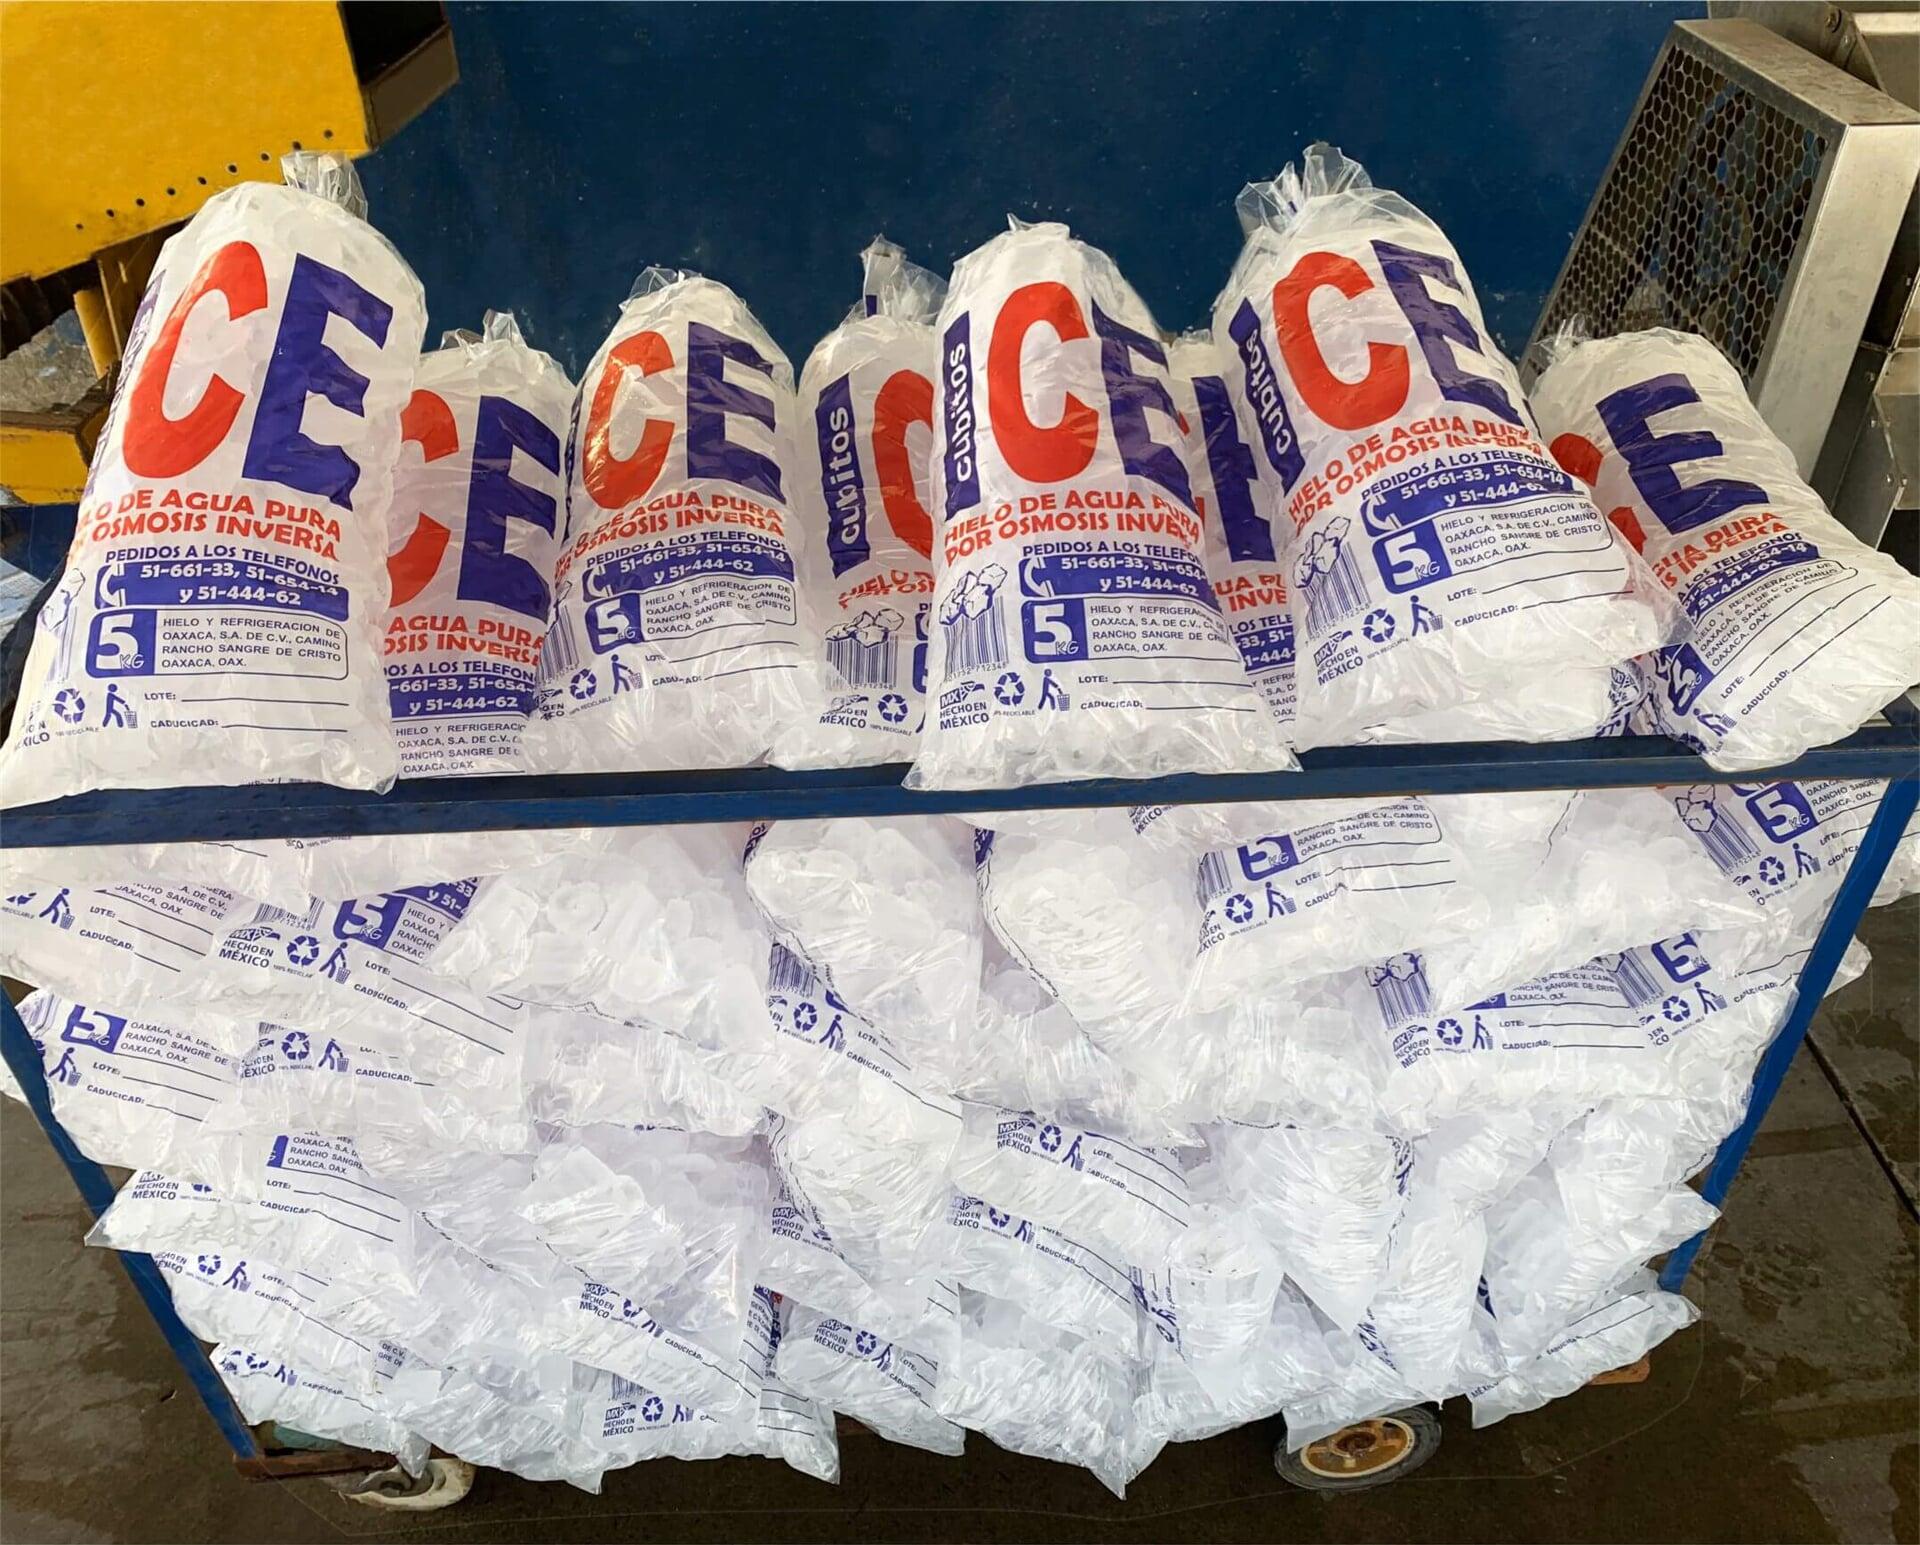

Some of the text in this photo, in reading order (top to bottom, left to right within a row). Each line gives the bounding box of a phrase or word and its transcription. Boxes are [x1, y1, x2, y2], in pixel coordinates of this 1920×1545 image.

[1245, 328, 1292, 455] cubitos
[950, 342, 972, 481] cubitos
[830, 407, 861, 544] cubitos
[1288, 416, 1468, 518] HIELO DE AGUA
[1335, 435, 1440, 496] OSMOSIS
[1361, 452, 1479, 501] PEDIDOS LOS
[1399, 464, 1565, 500] 51-661-33, 51-654-14
[118, 489, 342, 542] DE AGUA PURA
[630, 491, 784, 523] AGUA PURA
[1441, 502, 1575, 531] HIELO REFRIGERACION
[944, 490, 1145, 546] HIELO DE AGUA
[1444, 512, 1598, 544] OAXACA, CAMINO
[92, 510, 340, 562] OSMOSIS INVERSA
[574, 511, 669, 559] OSMOSIS
[675, 508, 785, 537] INVERSA
[945, 511, 1109, 567] POR OSMOSIS
[1450, 524, 1602, 555] RANCHO SANGRE DE CRISTO
[587, 543, 650, 568] PEDIDOS
[668, 534, 696, 546] LOS
[1023, 541, 1141, 557] PEDIDOS LOS
[1384, 532, 1441, 586] 5 KG
[105, 544, 340, 586] PEDIDOS LOS TELEFONOS
[669, 559, 754, 580] 51-444-62
[1061, 556, 1149, 570] 51-661-33,
[140, 563, 339, 597] 51-661-33, 51-654-14
[691, 581, 772, 595] REFRIGERACION
[1115, 575, 1199, 597] 51-444-62
[1729, 565, 1811, 609] REFRIGERACION
[196, 585, 301, 606] 51-444-62
[1447, 588, 1478, 602] LOTE:
[1090, 605, 1121, 614] HIELO
[1454, 605, 1519, 628] CADUCICAD:
[163, 617, 341, 640] HIELO REFRIGERACION DE
[388, 615, 469, 634] AGUA
[595, 598, 629, 646] 5
[1033, 602, 1079, 657] 5 KG
[1091, 617, 1177, 627] OAXACA, DE
[1229, 619, 1255, 635] LOS
[1701, 592, 1769, 650] OAXACA, DE
[1705, 593, 1780, 658] RANCHO SANGRE
[95, 614, 145, 670] 5 KG
[162, 630, 341, 651] OAXACA, S.A. DE CAMINO
[1092, 630, 1203, 640] RANCHO SANGRE DE
[1711, 612, 1772, 667] OAXACA, OAX.
[161, 656, 248, 670] OAXACA, OAX.
[162, 643, 342, 663] RANCHO SANGRE DE CRISTO
[429, 662, 458, 674] LOS
[1317, 655, 1364, 685] MÉXICO
[1078, 675, 1108, 683] LOTE:
[1721, 674, 1745, 699] LOTE:
[144, 691, 177, 702] LOTE:
[1741, 670, 1790, 716] CADUCICAD:
[425, 697, 518, 711] 51-444-62
[150, 718, 220, 730] CADUCICAD:
[395, 727, 428, 736] HIELO
[940, 713, 990, 730] MÉXICO
[398, 736, 486, 748] OAXACA, DE
[400, 748, 493, 760] RANCHO SANGRE
[1811, 787, 1849, 806] RANCHO
[1753, 788, 1802, 836] 5
[1297, 821, 1432, 846] RANCHO SANGRE CRISTO
[1301, 838, 1341, 856] OAXACA,
[1295, 872, 1321, 886] LOTE:
[90, 906, 116, 918] LOTE:
[161, 903, 183, 916] OAX.
[166, 892, 225, 920] SANGRE DE
[407, 908, 436, 925] HIELO
[359, 925, 383, 940] KG
[397, 929, 435, 951] RANCHO
[402, 920, 441, 941] OAXACA,
[219, 948, 270, 969] MÉXICO
[224, 940, 274, 958] HECHO EN
[365, 960, 391, 976] LOTE:
[354, 983, 409, 1012] CADUCICAD:
[1500, 1020, 1524, 1028] LOTE:
[120, 1042, 163, 1059] OAXACA,
[126, 1032, 229, 1066] RANCHO SANGRE DE
[93, 1060, 121, 1076] LOTE:
[355, 1068, 413, 1082] CADUCICAD:
[847, 1051, 893, 1079] CADUCICAD:
[87, 1084, 145, 1105] CADUCICAD:
[290, 1147, 329, 1159] RANCHO
[293, 1137, 331, 1149] OAXACA,
[997, 1140, 1030, 1154] MÉXICO
[287, 1157, 326, 1170] OAXACA,
[134, 1182, 179, 1190] HECHO EN
[267, 1179, 291, 1190] LOTE:
[132, 1190, 176, 1200] MÉXICO
[262, 1273, 285, 1286] LOTE:
[582, 1293, 604, 1308] HECHO
[814, 1335, 844, 1354] MÉXICO
[816, 1327, 847, 1345] HECHO EN
[603, 1426, 633, 1437] MÉXICO
[604, 1419, 625, 1427] HECHO
